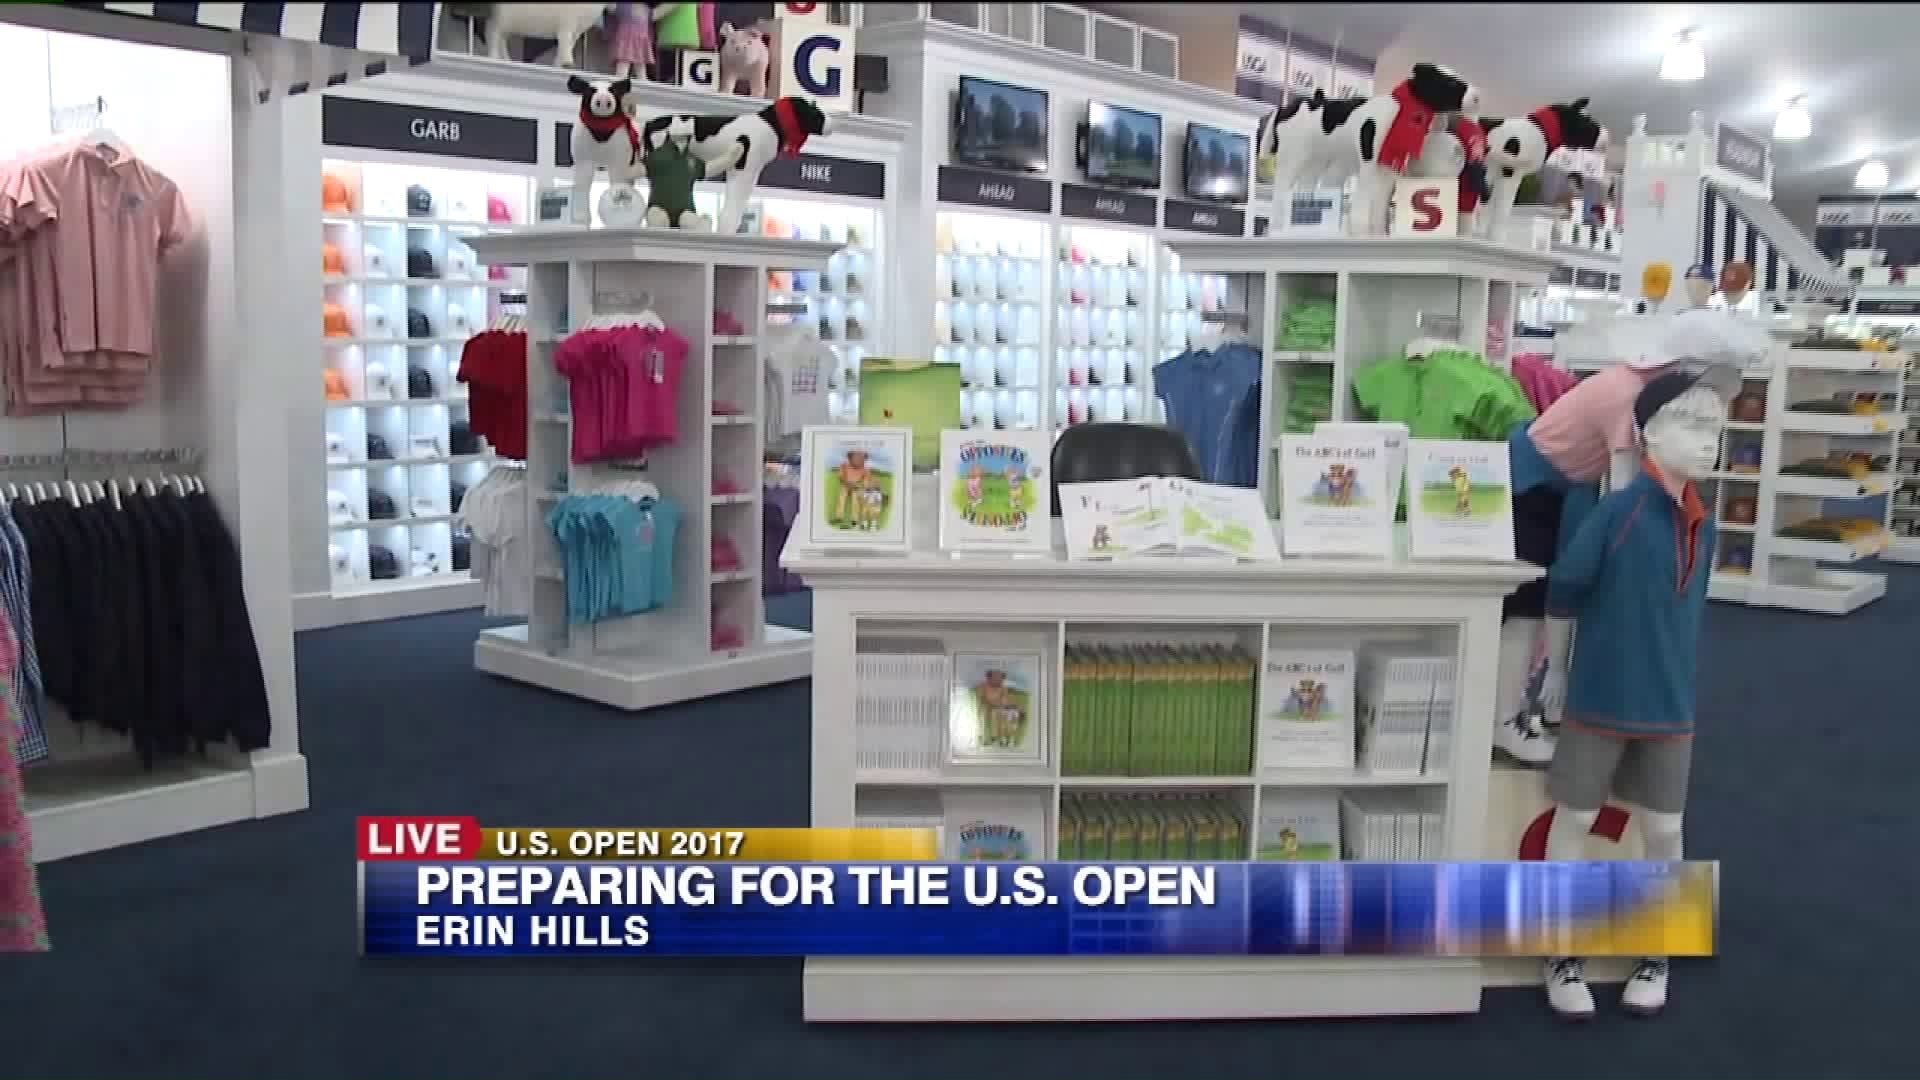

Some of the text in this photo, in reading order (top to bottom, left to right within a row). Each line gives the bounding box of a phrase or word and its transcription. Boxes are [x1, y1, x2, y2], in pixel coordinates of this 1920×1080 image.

[689, 58, 713, 86] G
[796, 35, 841, 96] G
[410, 118, 460, 141] GARB
[800, 164, 833, 182] NIKE
[1410, 189, 1443, 231] S
